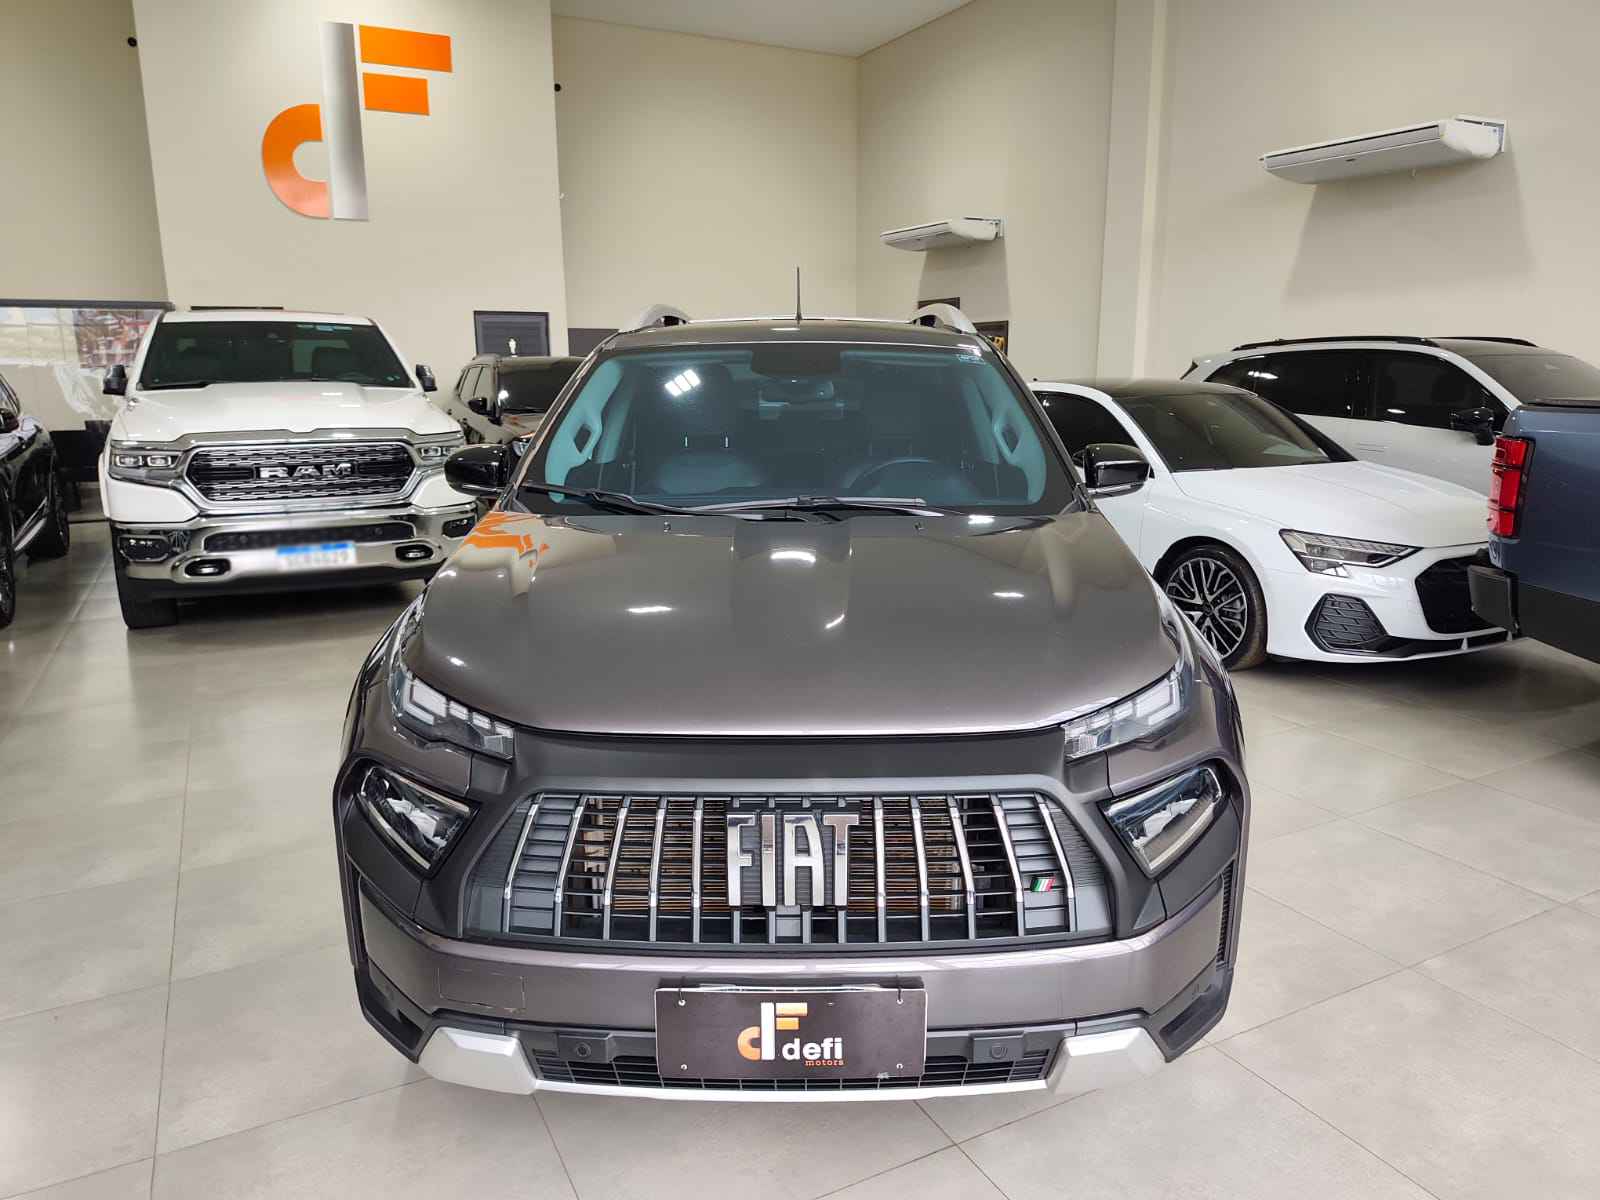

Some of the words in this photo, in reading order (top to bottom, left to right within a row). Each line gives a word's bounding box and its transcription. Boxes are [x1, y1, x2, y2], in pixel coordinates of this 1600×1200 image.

[260, 463, 353, 479] RAM
[726, 814, 860, 907] FIAT
[782, 1037, 843, 1060] defi
